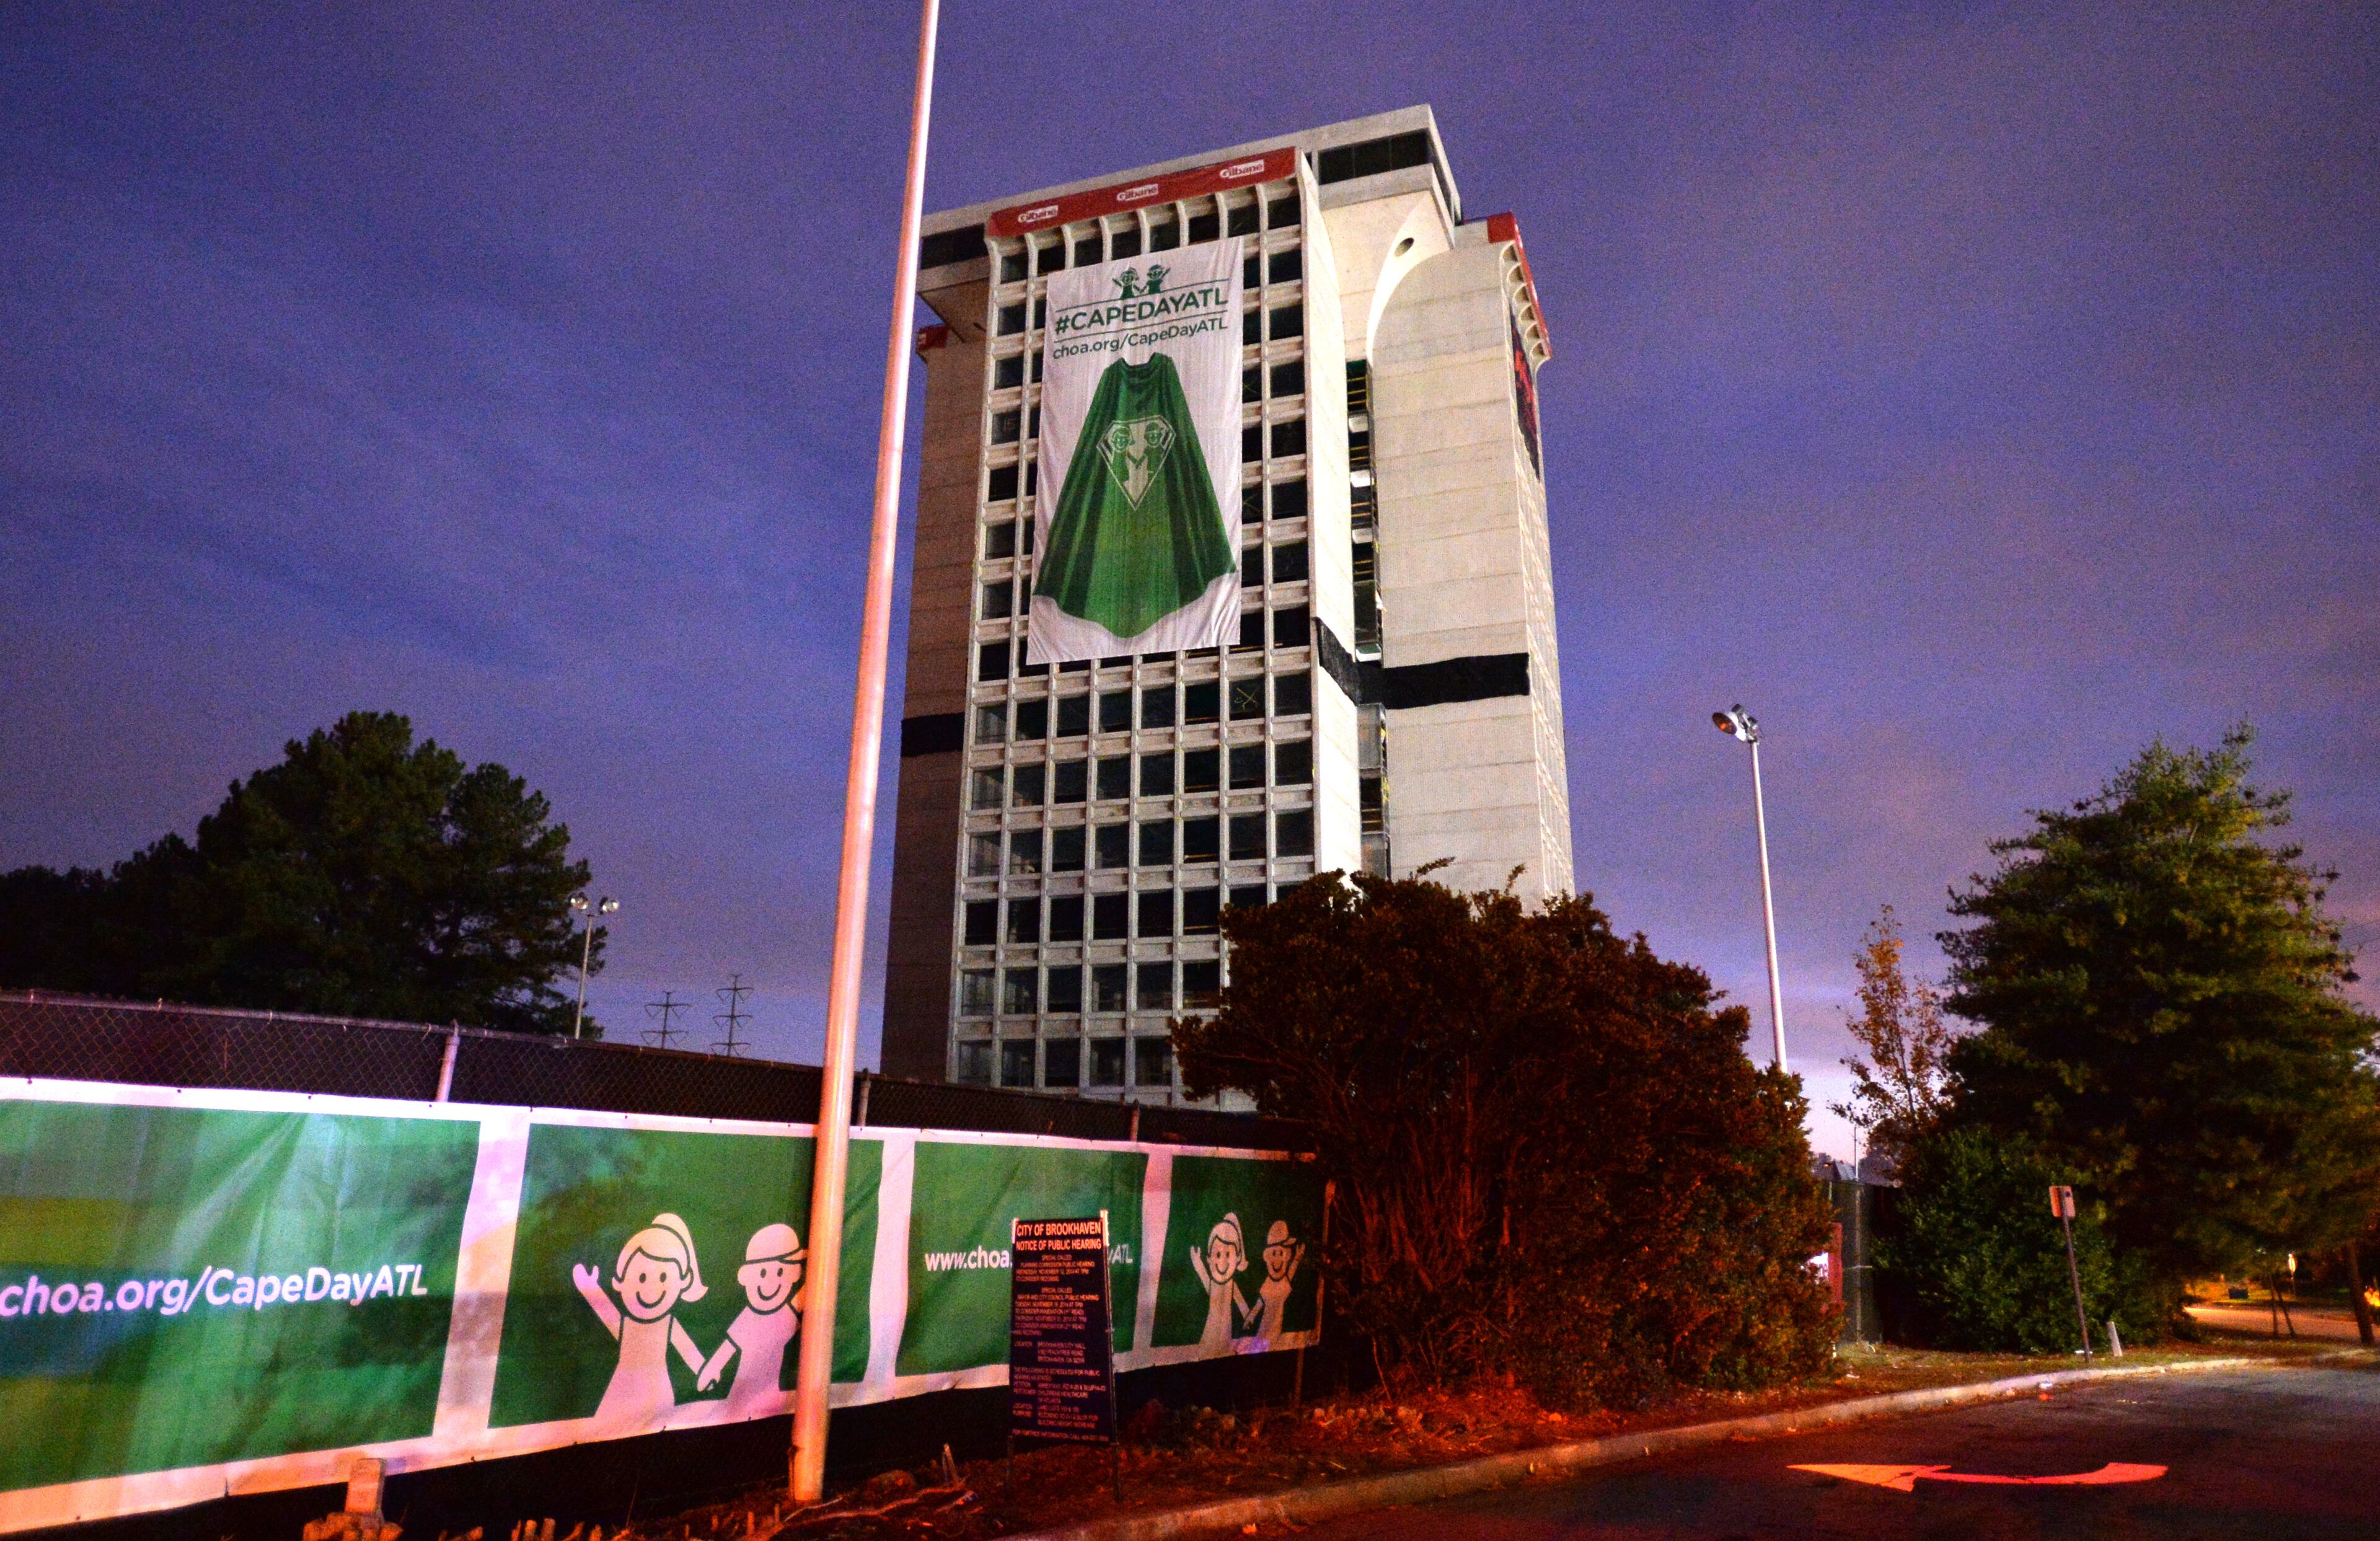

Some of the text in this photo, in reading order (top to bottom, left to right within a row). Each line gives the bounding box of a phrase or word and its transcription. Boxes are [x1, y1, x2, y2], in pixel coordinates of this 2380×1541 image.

[1055, 287, 1228, 335] #CAPEDAYATL
[1052, 317, 1228, 360] choa.org/CapeDayATL
[1016, 1221, 1101, 1237] CITY OF BROOKHAVEN
[1016, 1239, 1102, 1251] NOTICE OF PUBLIC HEARING
